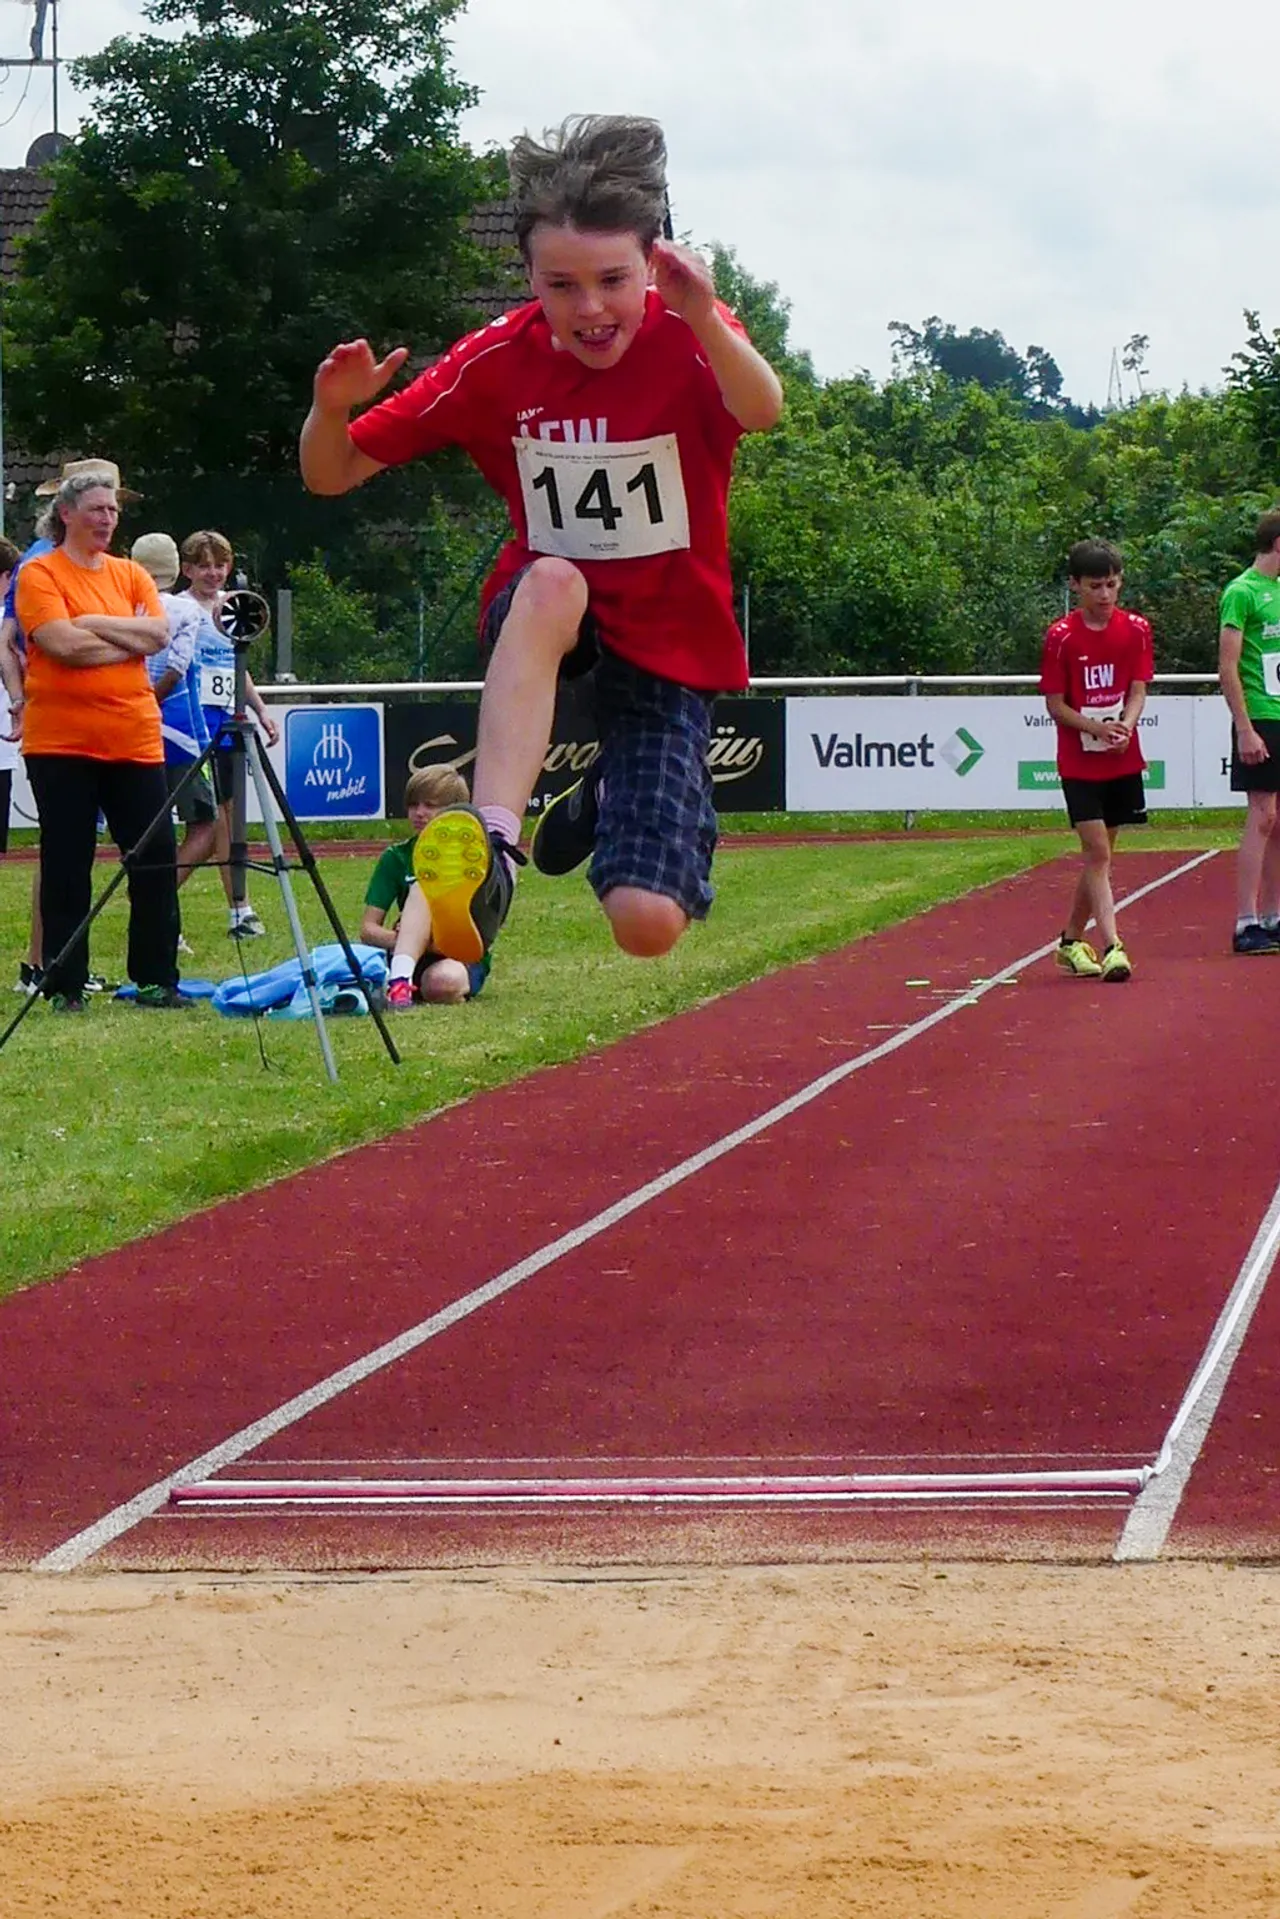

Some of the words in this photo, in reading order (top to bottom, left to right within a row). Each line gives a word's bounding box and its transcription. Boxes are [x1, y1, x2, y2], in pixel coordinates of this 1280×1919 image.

[532, 462, 664, 530] 141
[1084, 663, 1114, 690] LEW
[810, 733, 935, 768] Valmet
[304, 768, 342, 786] AWI
[326, 775, 367, 803] mobil
